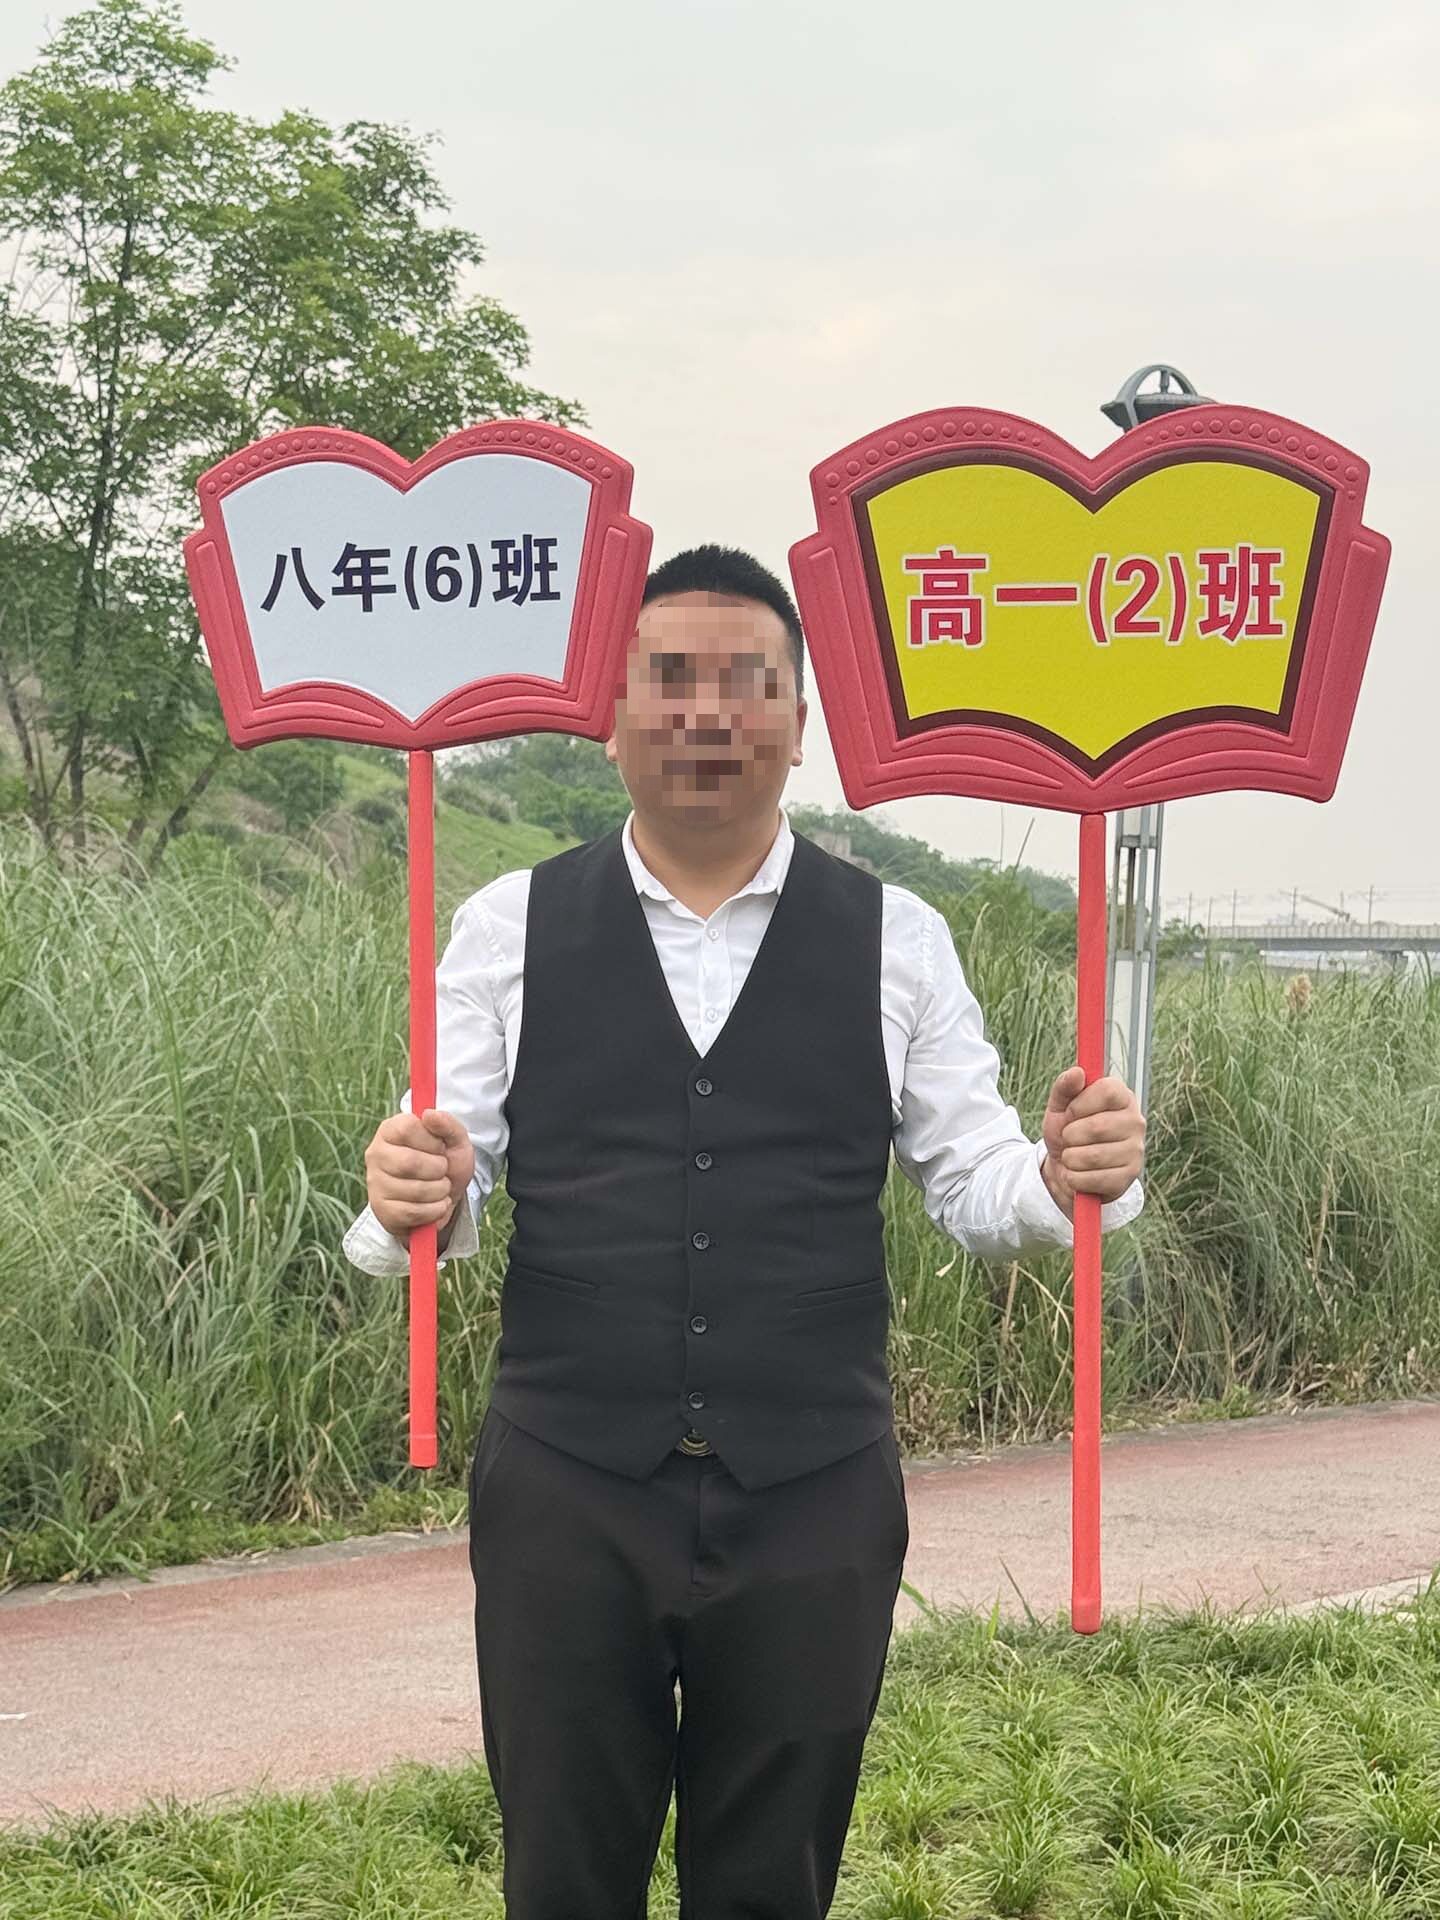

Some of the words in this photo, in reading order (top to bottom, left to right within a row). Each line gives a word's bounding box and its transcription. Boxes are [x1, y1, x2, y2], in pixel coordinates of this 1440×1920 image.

[260, 533, 561, 613] 八年(6)班
[903, 544, 1285, 647] 高一(2)班
